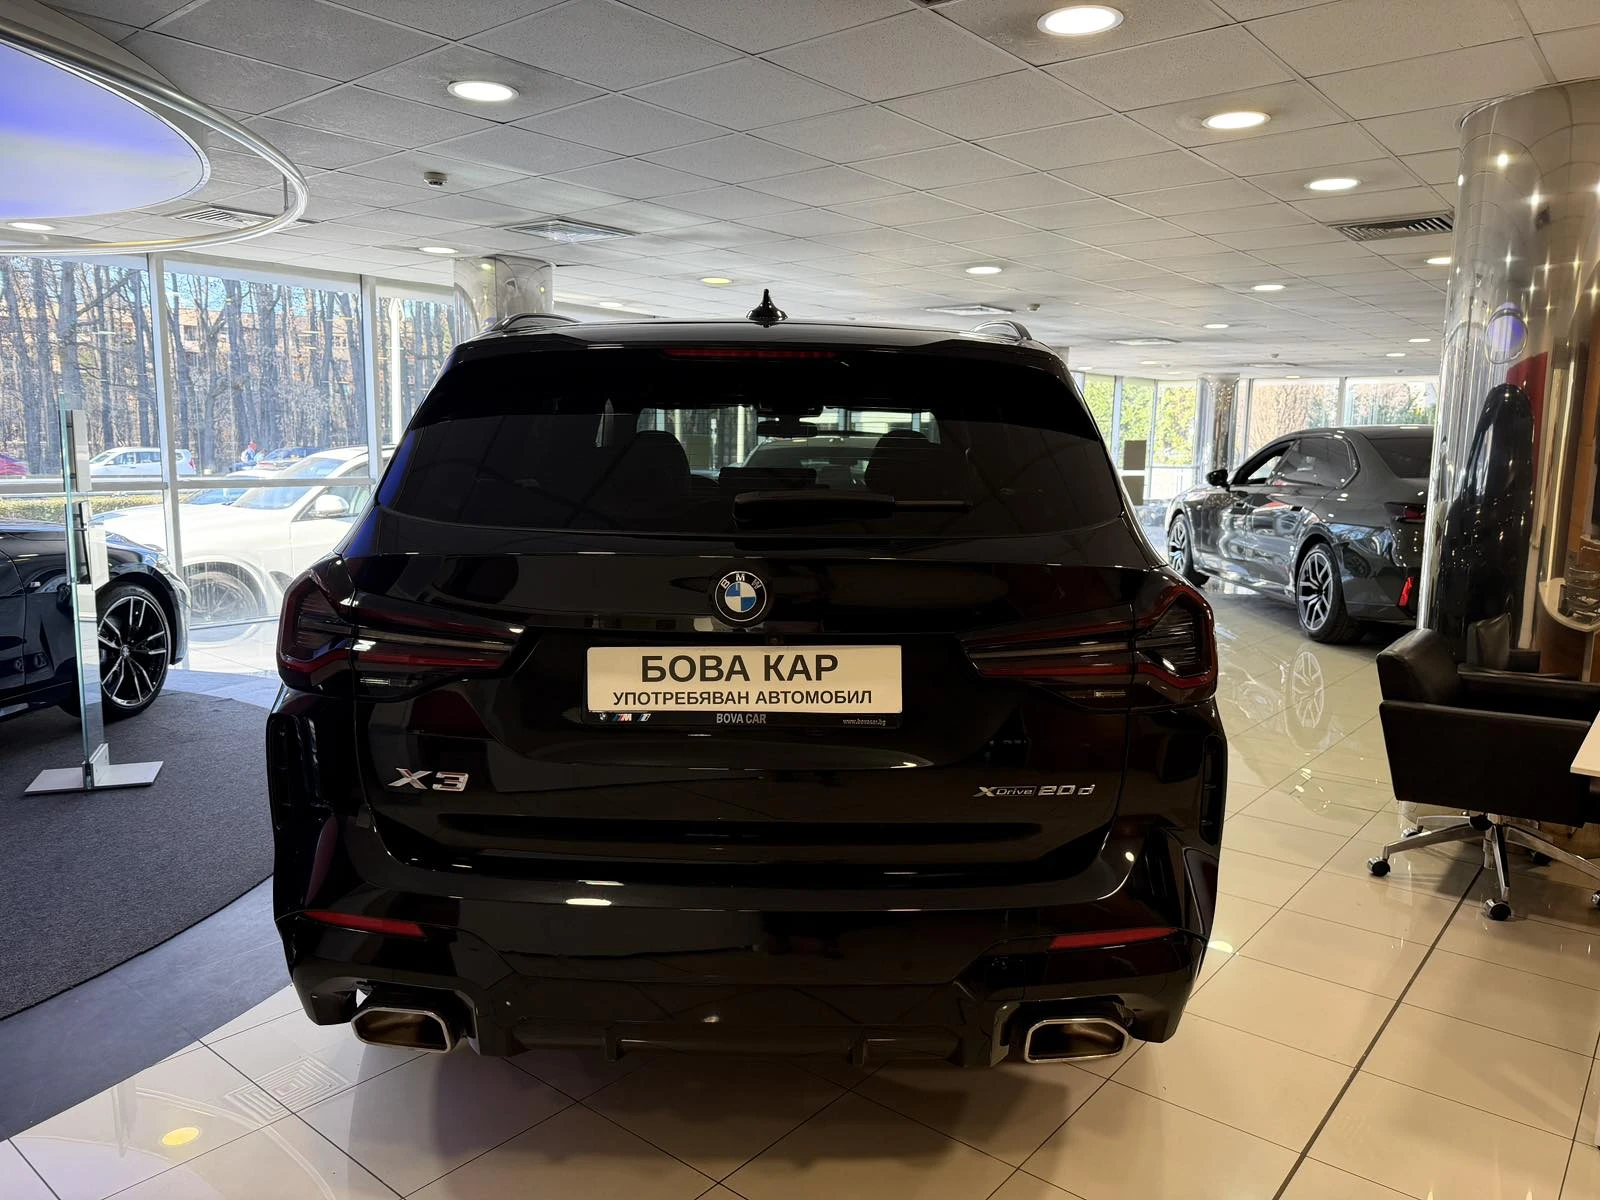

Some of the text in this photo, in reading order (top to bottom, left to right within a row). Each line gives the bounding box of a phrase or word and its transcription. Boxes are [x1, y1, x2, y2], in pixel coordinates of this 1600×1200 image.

[720, 573, 762, 590] BMW
[641, 653, 839, 683] БОВА КАР
[612, 689, 873, 706] УПОТРЕБЯВАН АВТОМОБИЛ
[716, 713, 767, 724] BOVA CAR
[387, 767, 469, 792] X3
